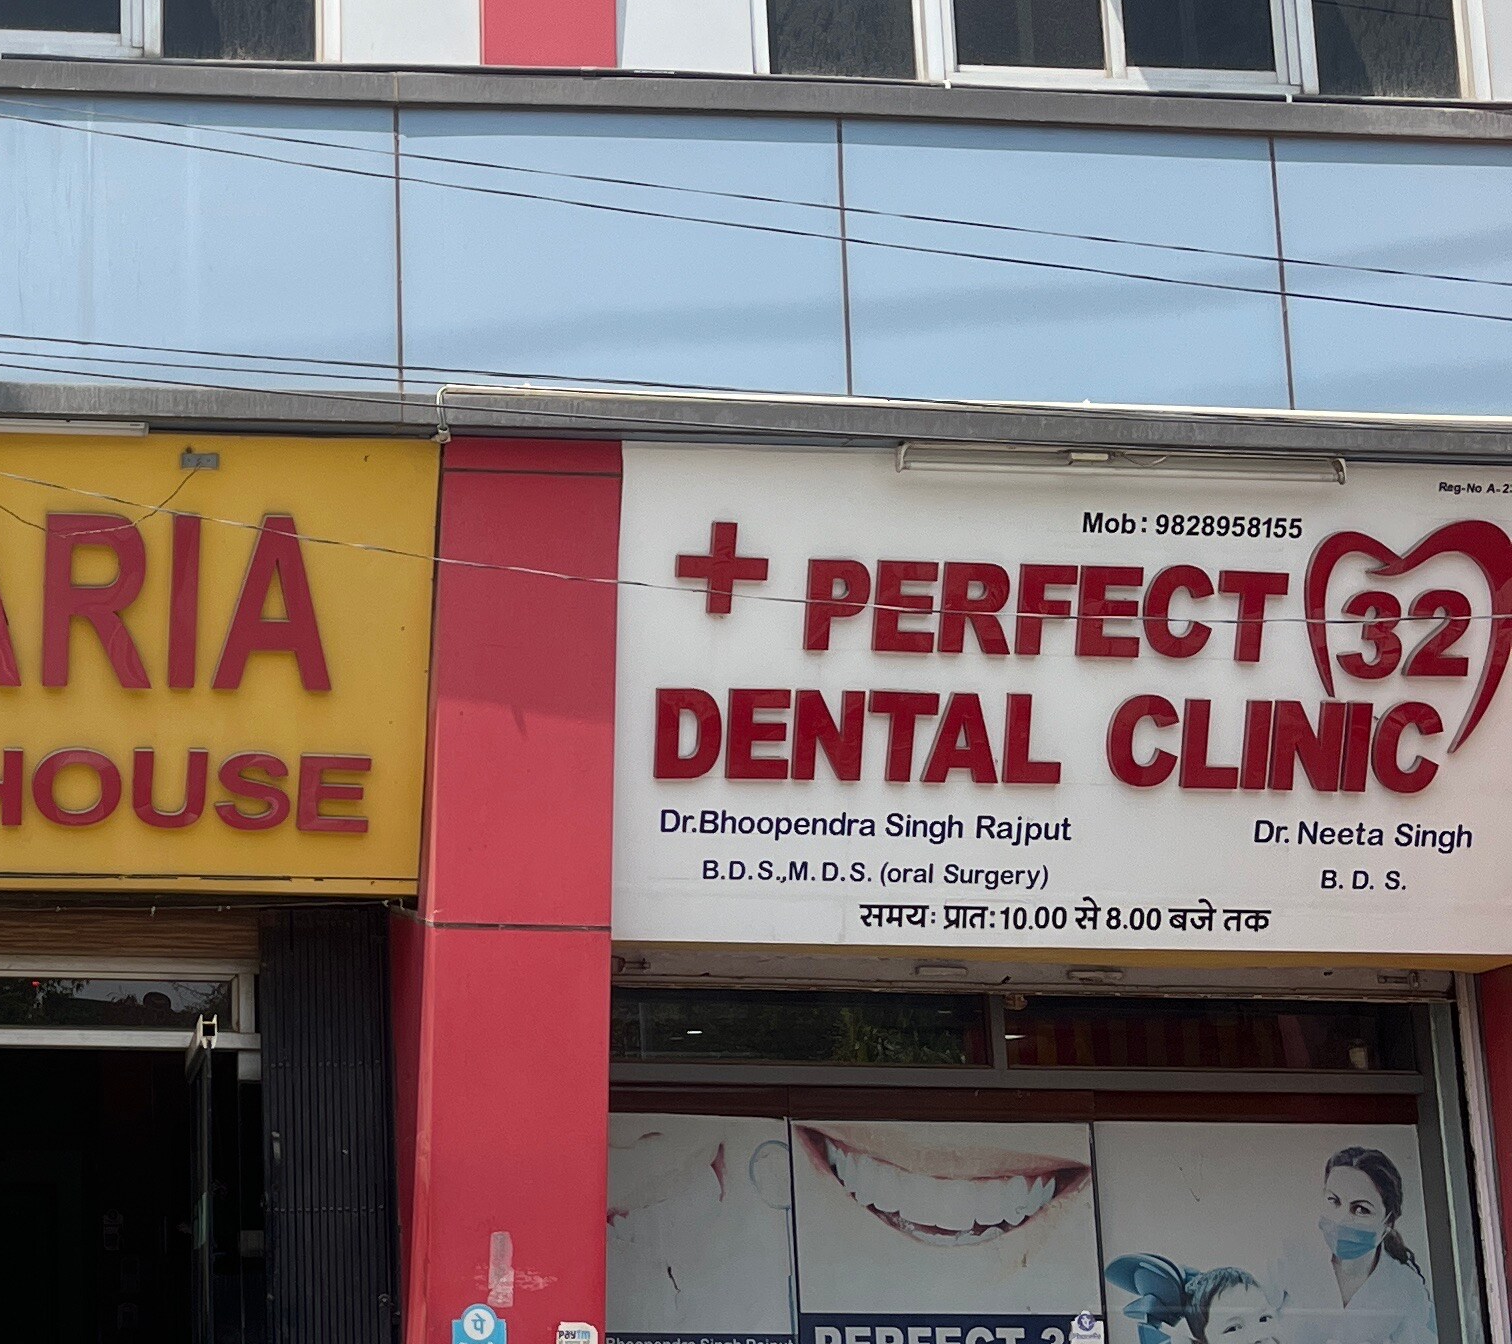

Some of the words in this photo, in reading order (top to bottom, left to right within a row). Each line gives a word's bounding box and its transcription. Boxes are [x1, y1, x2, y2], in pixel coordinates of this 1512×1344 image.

[1486, 482, 1512, 494] A-2
[1154, 513, 1304, 539] 9828958155
[803, 558, 1290, 663] PERFECT
[1335, 589, 1472, 681] 32
[653, 687, 1062, 785] DENTAL
[1106, 693, 1445, 794] CLINIC
[885, 812, 964, 845] Singh
[975, 815, 1072, 846] Rajput
[1253, 819, 1290, 844] Dr.
[1297, 820, 1384, 846] Neeta
[1394, 822, 1474, 854] Singh
[880, 861, 934, 887] (oral
[942, 863, 1050, 890] Surgery)
[1074, 895, 1101, 931] से
[1106, 906, 1162, 931] 8.00
[1168, 898, 1217, 932] बजे
[1222, 909, 1272, 932] तक
